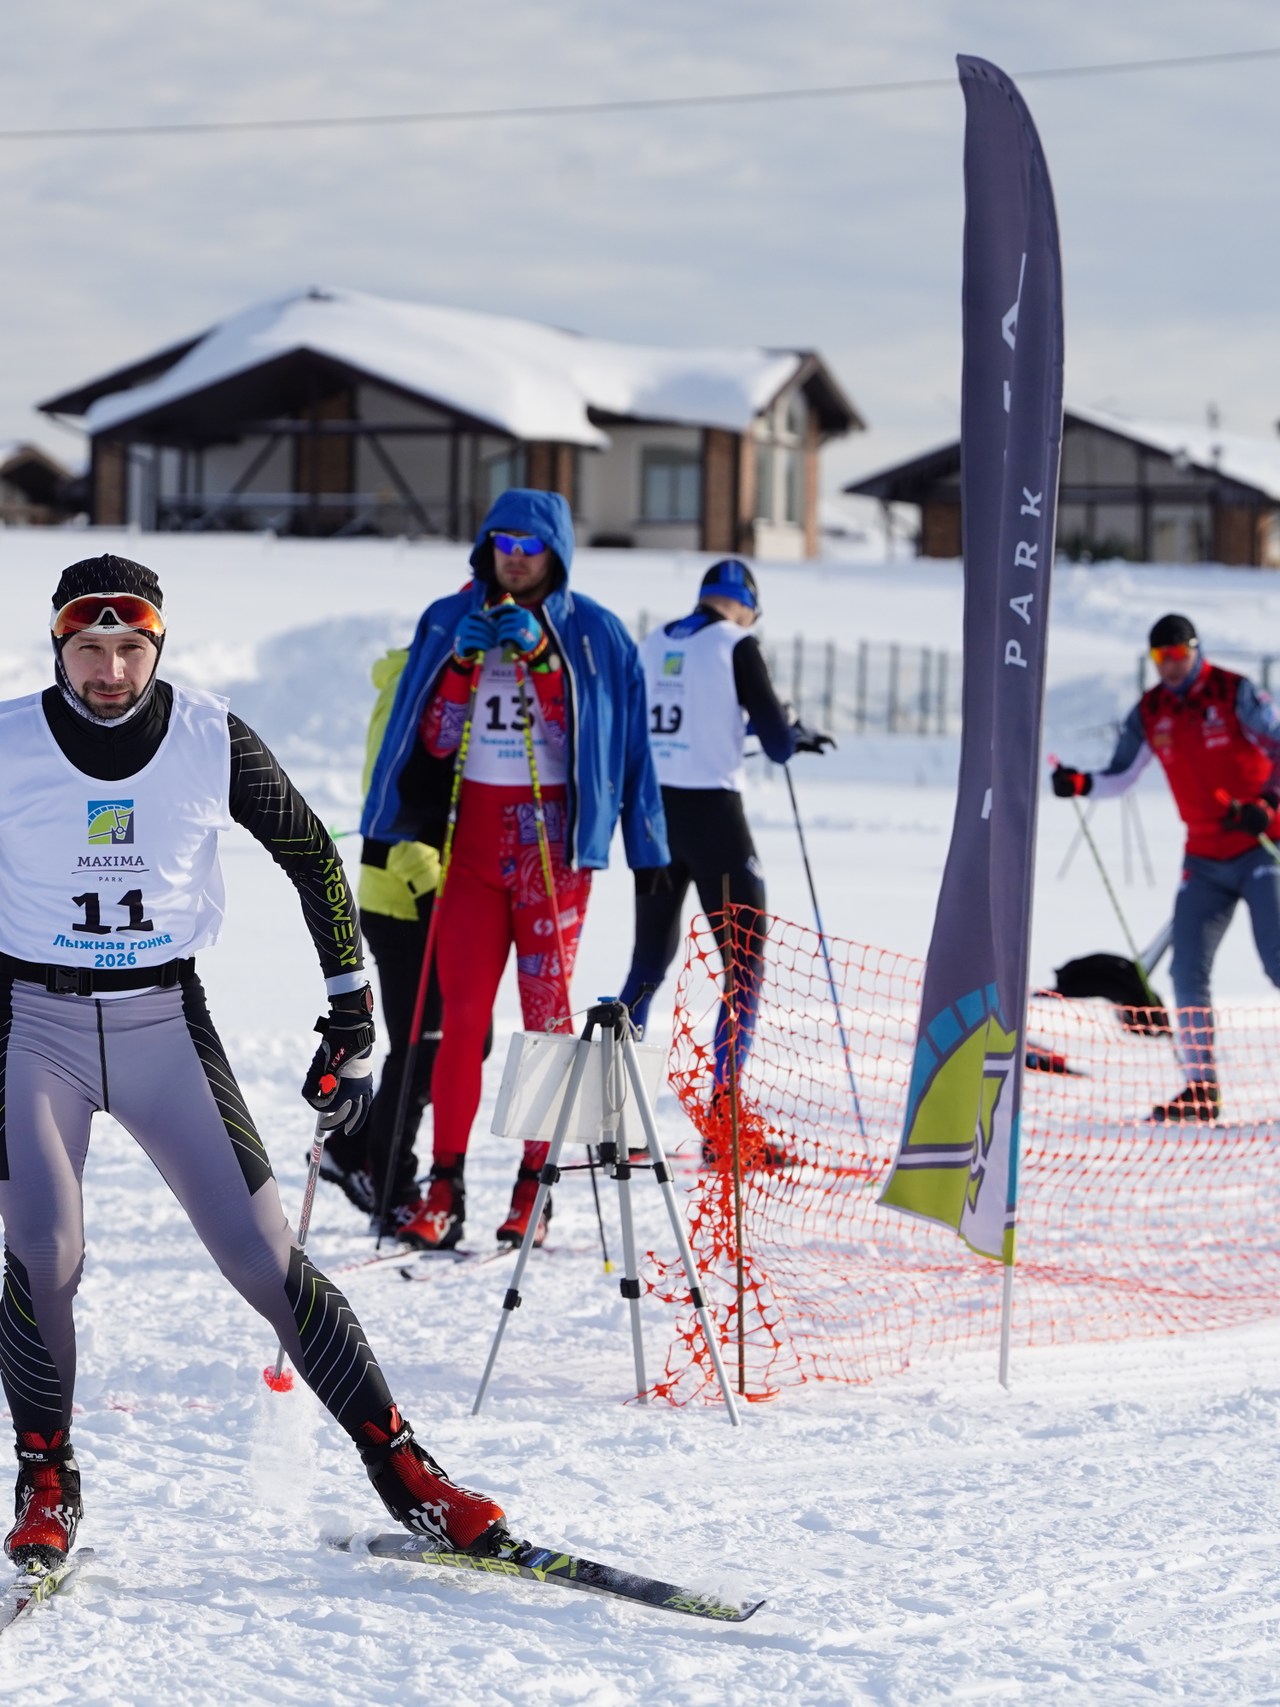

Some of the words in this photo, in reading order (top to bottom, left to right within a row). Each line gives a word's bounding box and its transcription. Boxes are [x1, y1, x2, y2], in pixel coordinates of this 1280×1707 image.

[1004, 487, 1042, 668] PARK
[486, 695, 534, 730] 13
[651, 703, 682, 734] 19
[77, 855, 145, 867] MAXIMA
[72, 889, 154, 935] 11
[53, 934, 126, 950] Лыжная
[130, 933, 173, 951] гонка
[94, 952, 137, 967] 2026
[422, 1551, 521, 1577] FISCHER
[663, 1595, 740, 1620] FISCHER
